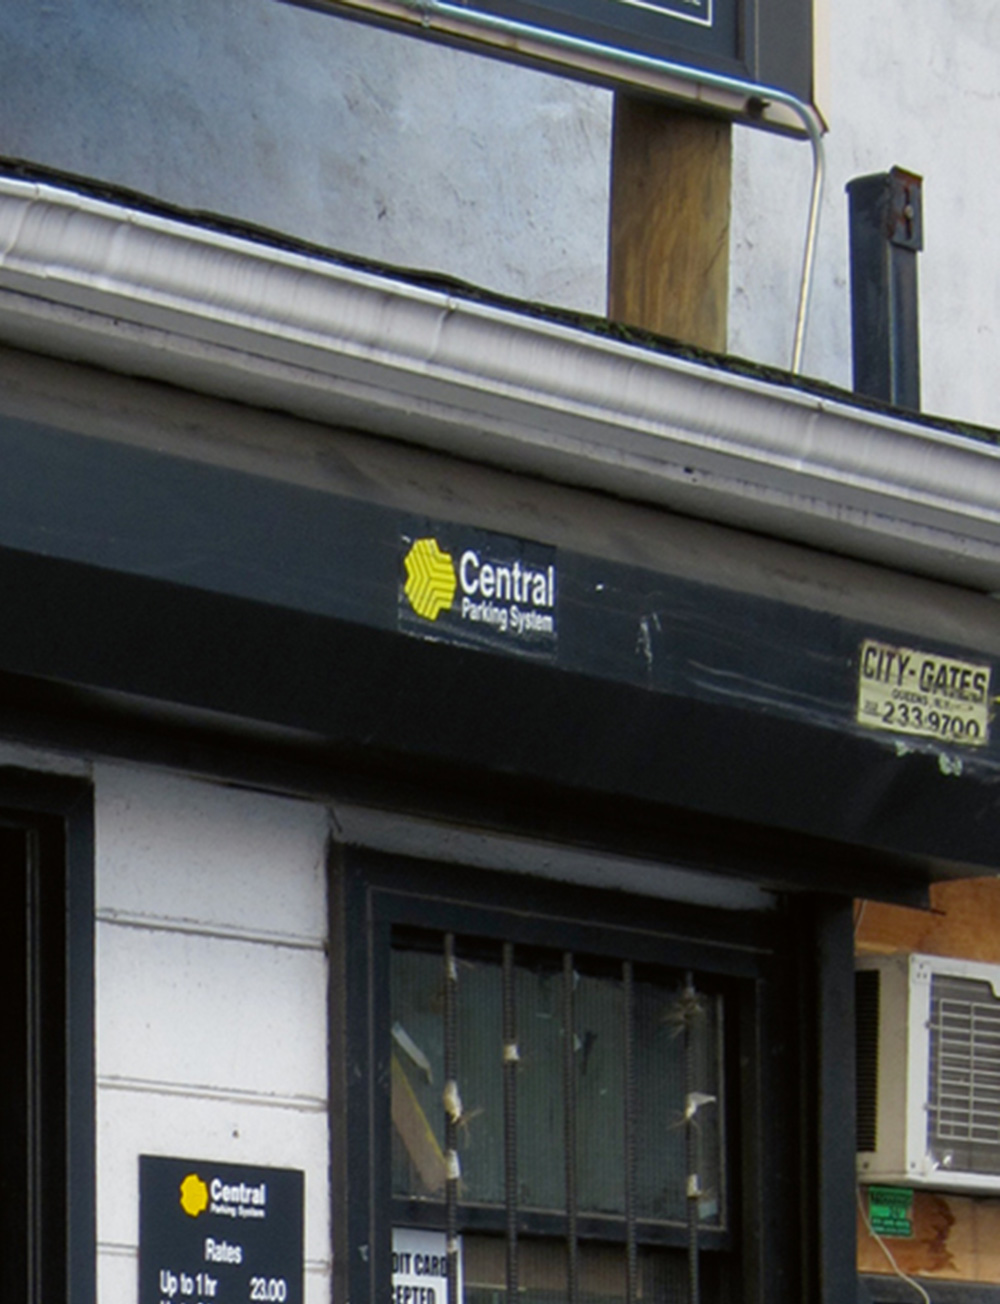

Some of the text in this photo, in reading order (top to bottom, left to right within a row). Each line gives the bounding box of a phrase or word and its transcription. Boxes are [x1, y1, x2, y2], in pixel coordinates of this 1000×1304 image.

[459, 550, 555, 607] Central
[461, 596, 553, 634] Parking System
[210, 1178, 266, 1205] Central
[204, 1238, 242, 1264] Rates
[160, 1270, 218, 1298] Up to 1 hr
[249, 1276, 287, 1302] 23.00
